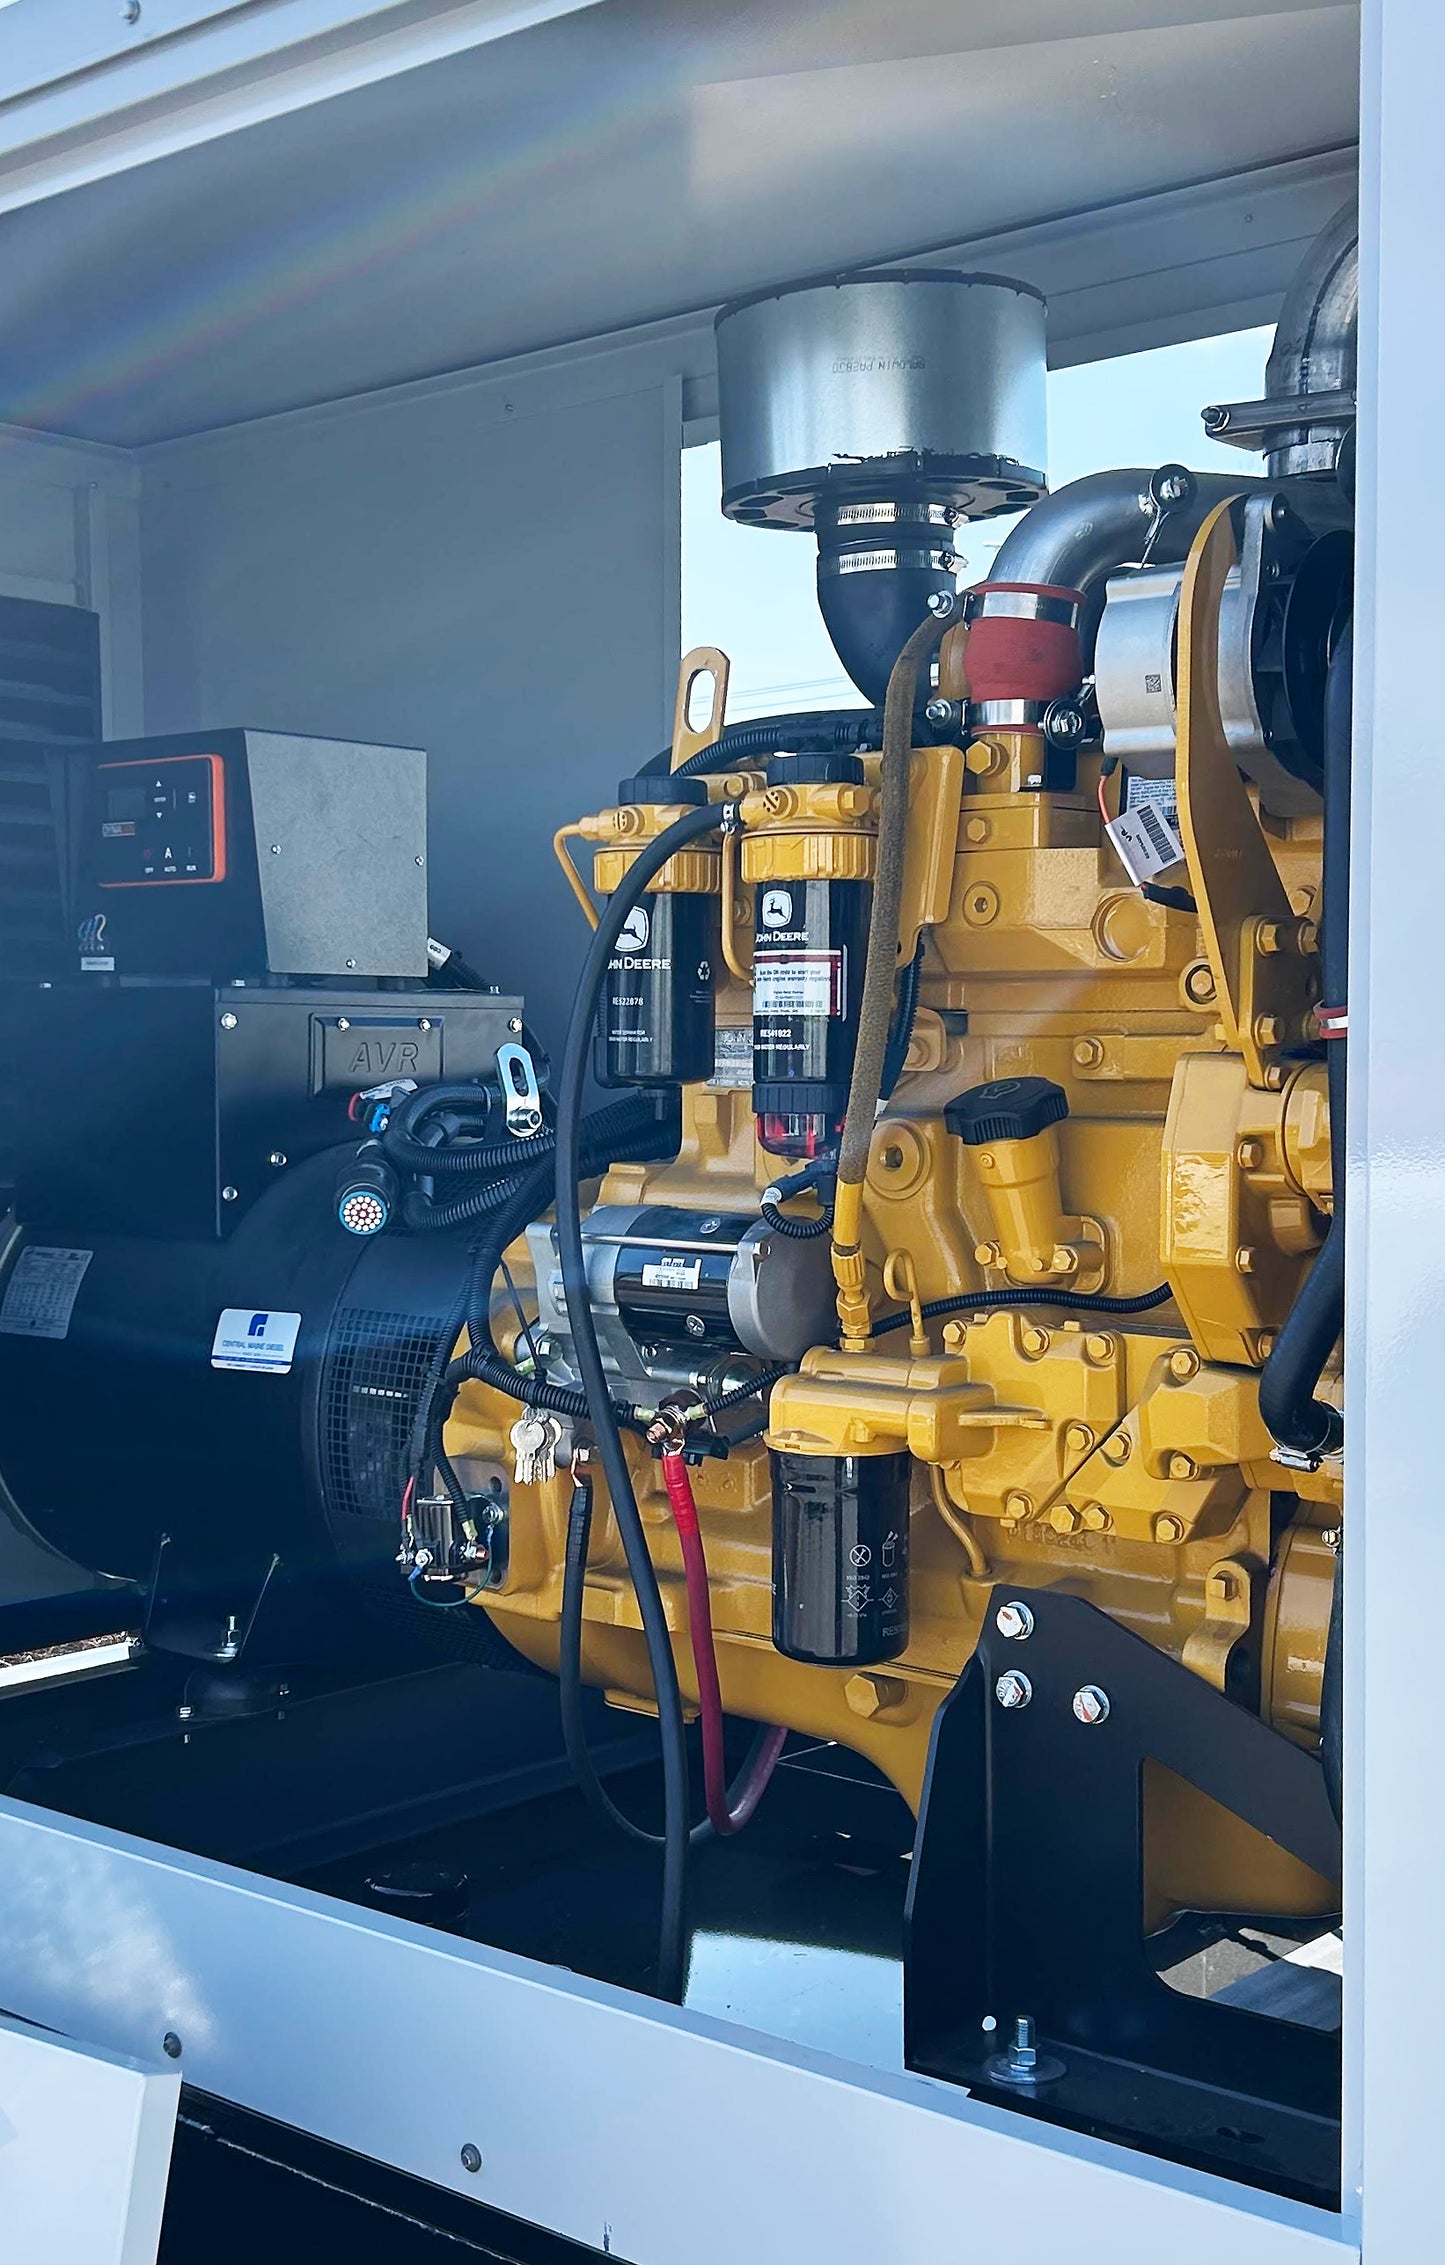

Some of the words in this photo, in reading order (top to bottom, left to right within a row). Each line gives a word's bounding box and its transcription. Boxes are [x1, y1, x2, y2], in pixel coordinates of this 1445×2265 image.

[773, 930, 809, 942] DEERE
[624, 956, 671, 970] DEERE
[348, 1041, 419, 1073] AVR
